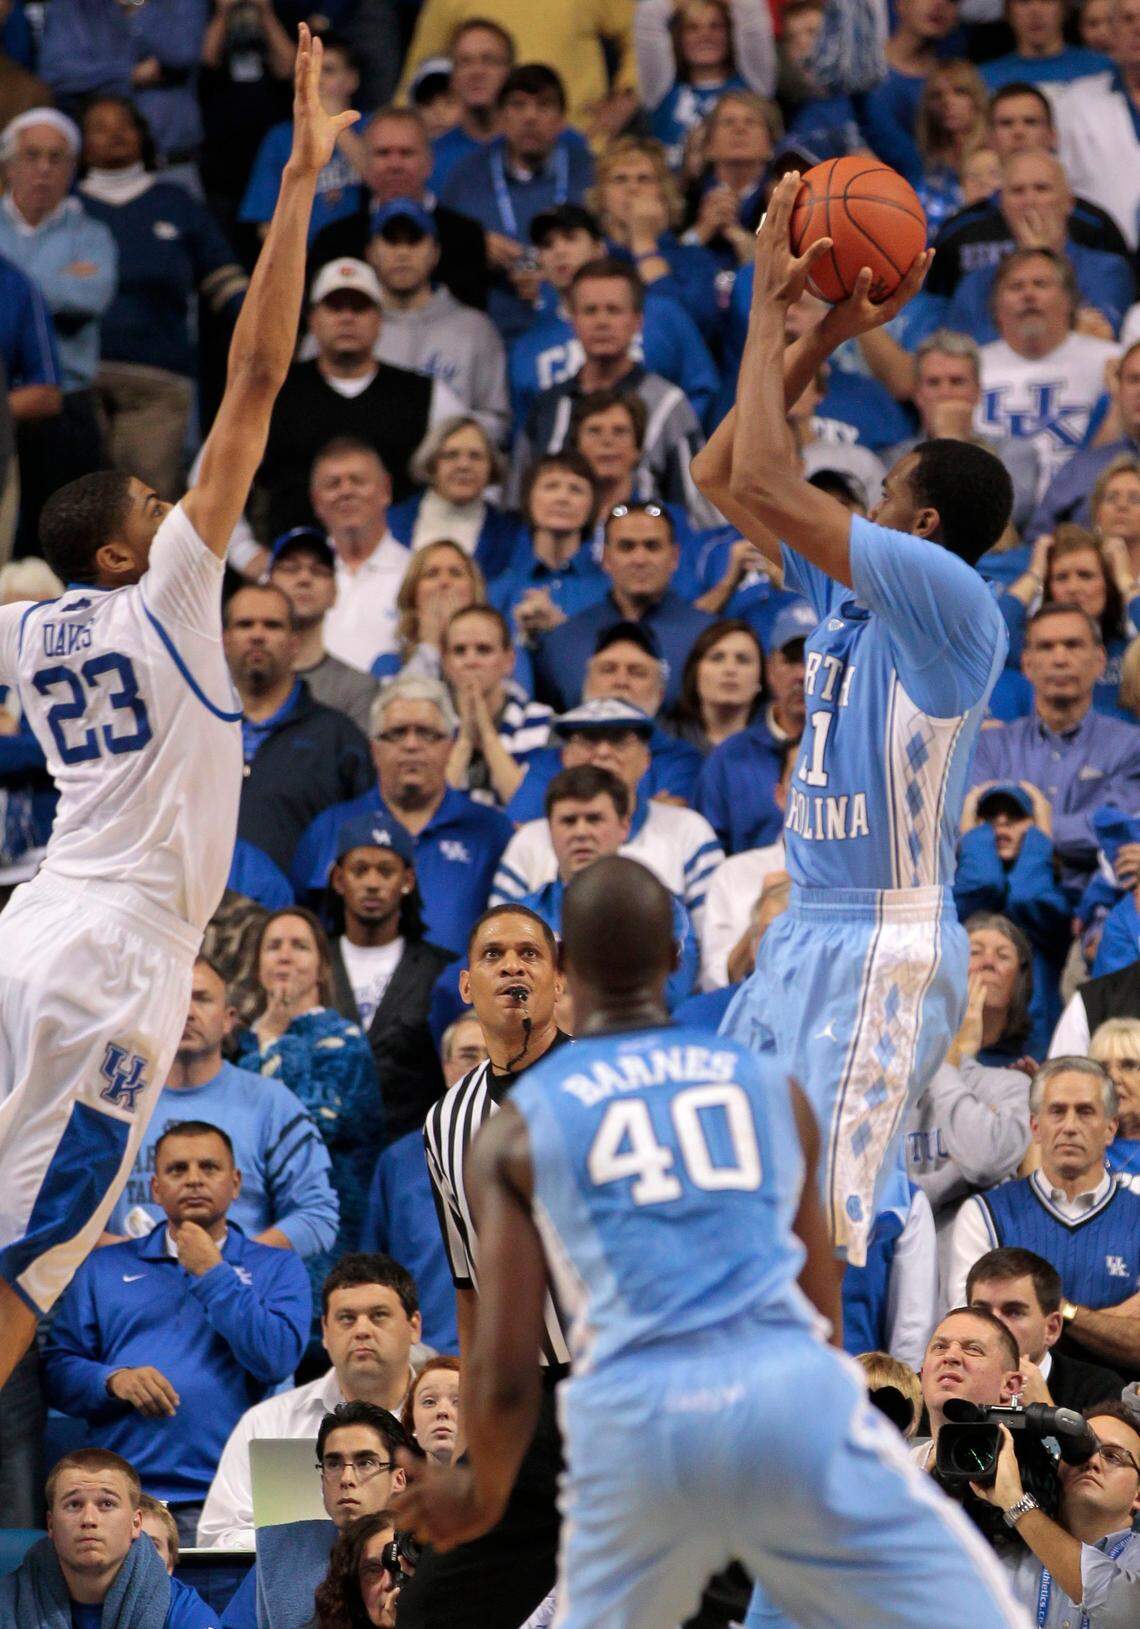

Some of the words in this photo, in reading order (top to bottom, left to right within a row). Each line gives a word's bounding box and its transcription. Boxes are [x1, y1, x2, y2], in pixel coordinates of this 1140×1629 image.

[32, 652, 153, 765] 23
[100, 1042, 147, 1113] UK
[561, 1044, 738, 1108] BARNES
[587, 1083, 762, 1206] 40
